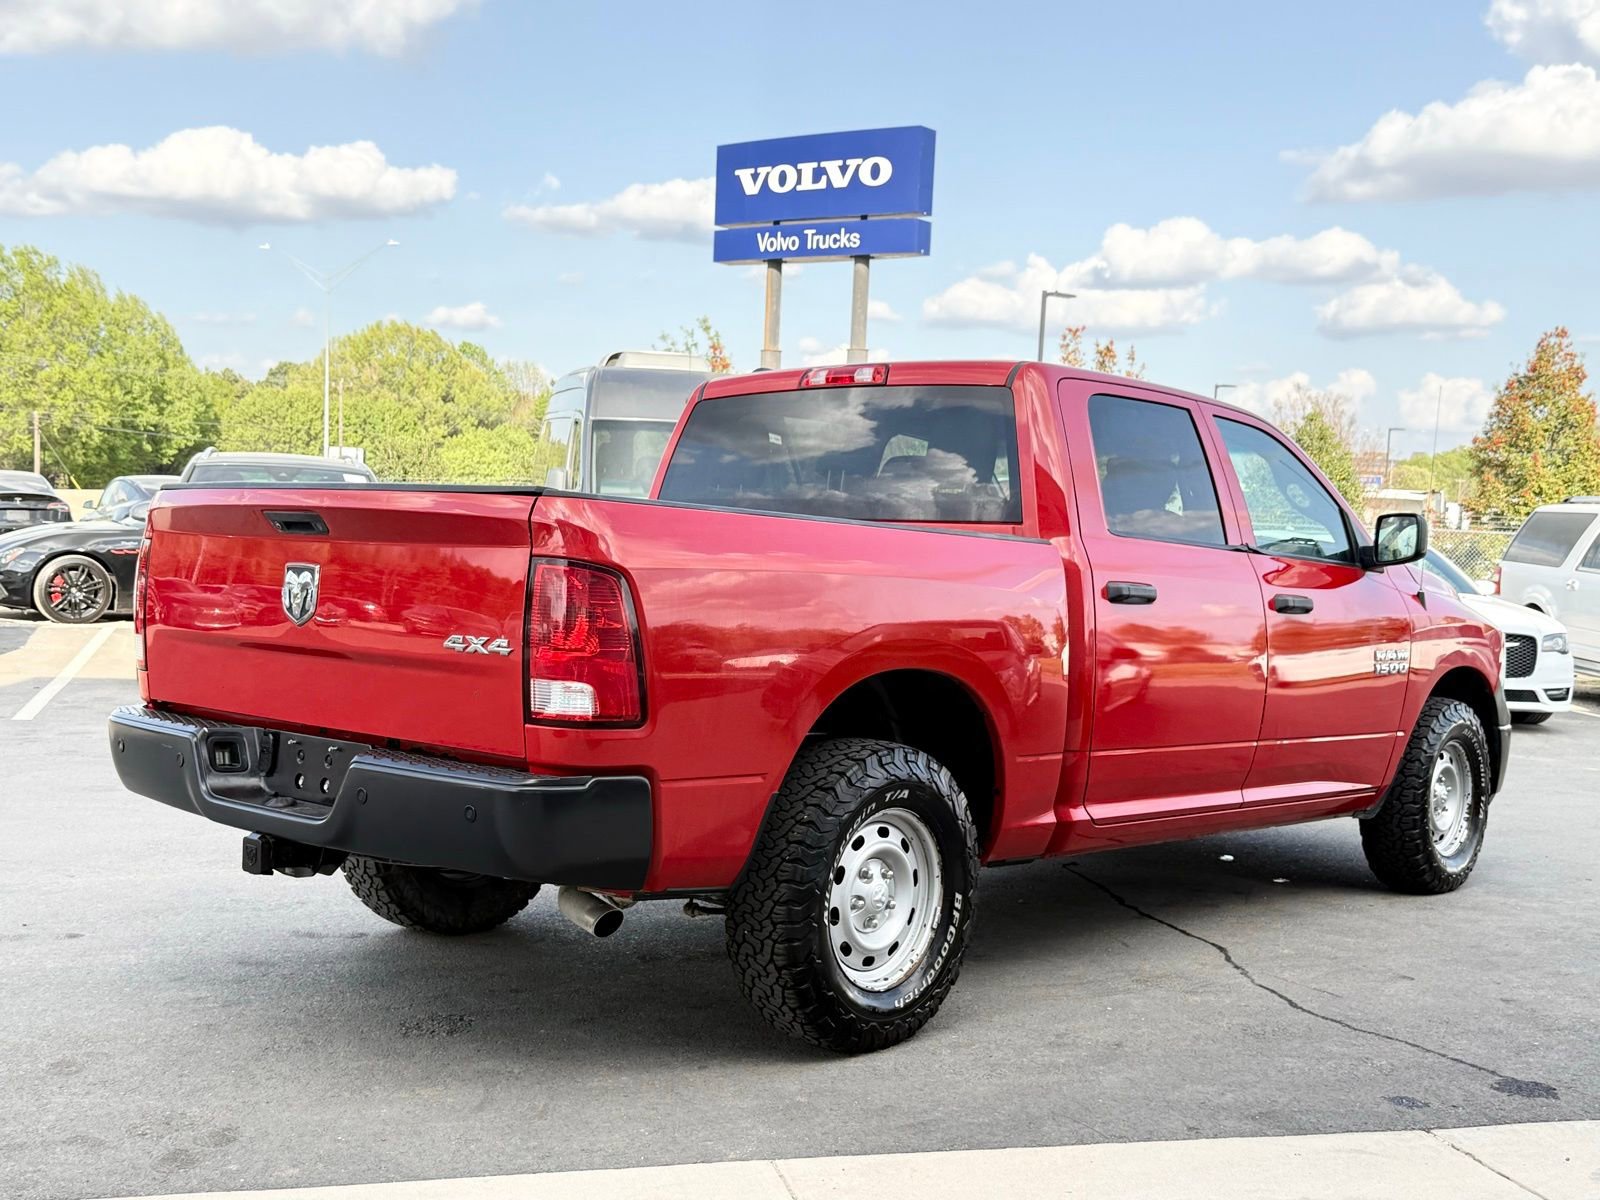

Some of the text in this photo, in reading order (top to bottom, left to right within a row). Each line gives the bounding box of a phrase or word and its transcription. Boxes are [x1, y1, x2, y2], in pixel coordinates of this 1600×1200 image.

[734, 155, 893, 196] VOLVO
[756, 227, 861, 253] Volvo Trucks
[1374, 650, 1409, 661] RAM
[1374, 662, 1409, 675] 1500
[884, 788, 910, 803] T/A
[894, 891, 963, 1009] BFGoodrich
